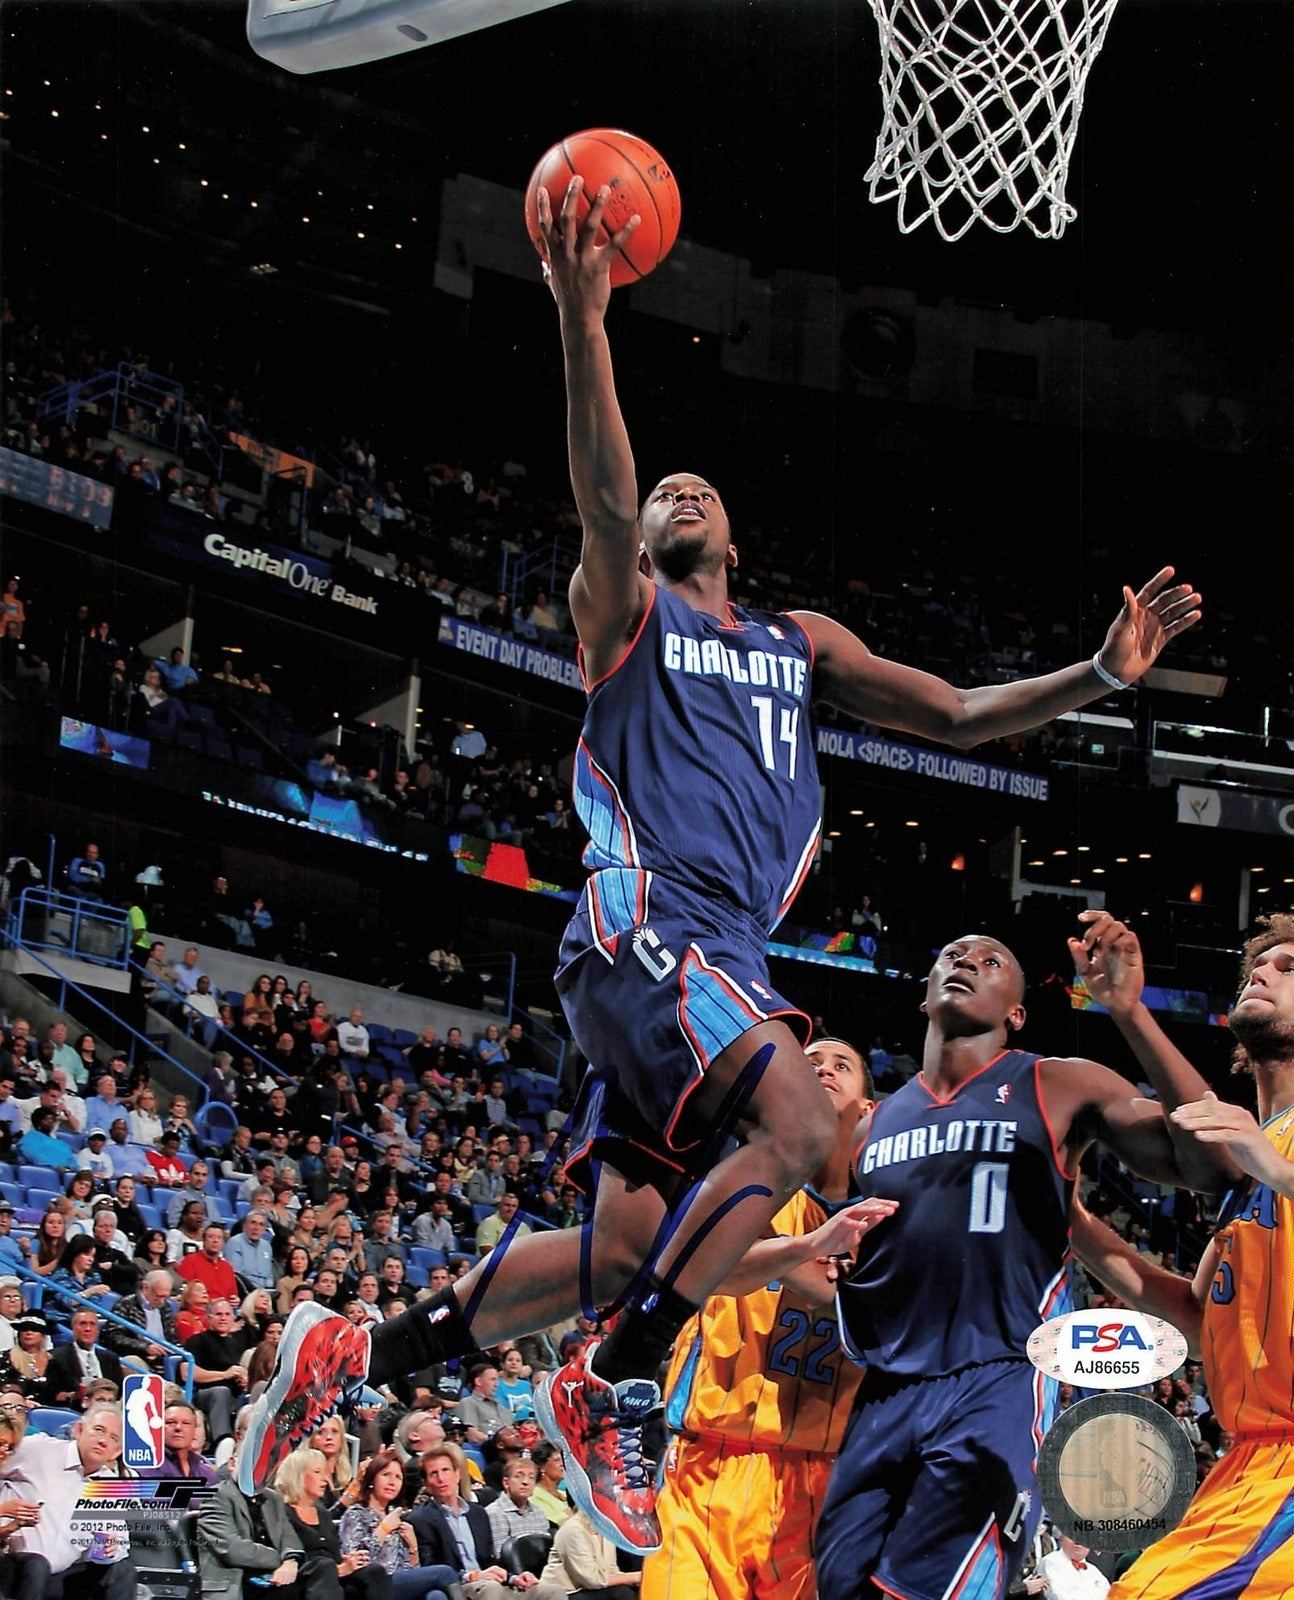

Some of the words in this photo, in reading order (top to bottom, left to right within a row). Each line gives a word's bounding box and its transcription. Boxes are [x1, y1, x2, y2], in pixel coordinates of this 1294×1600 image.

[331, 584, 378, 615] Bank
[456, 624, 498, 660] EVENT
[499, 640, 525, 669] DAY
[664, 632, 807, 697] CHARLOTTE
[750, 695, 799, 781] 14
[817, 730, 854, 759] NOLA
[917, 752, 987, 787] FOLLOWED
[989, 769, 1008, 792] BY
[1009, 777, 1048, 801] ISSUE
[862, 1120, 1018, 1175] CHARLOTTE
[968, 1161, 1009, 1233] 0
[767, 1307, 840, 1386] 22
